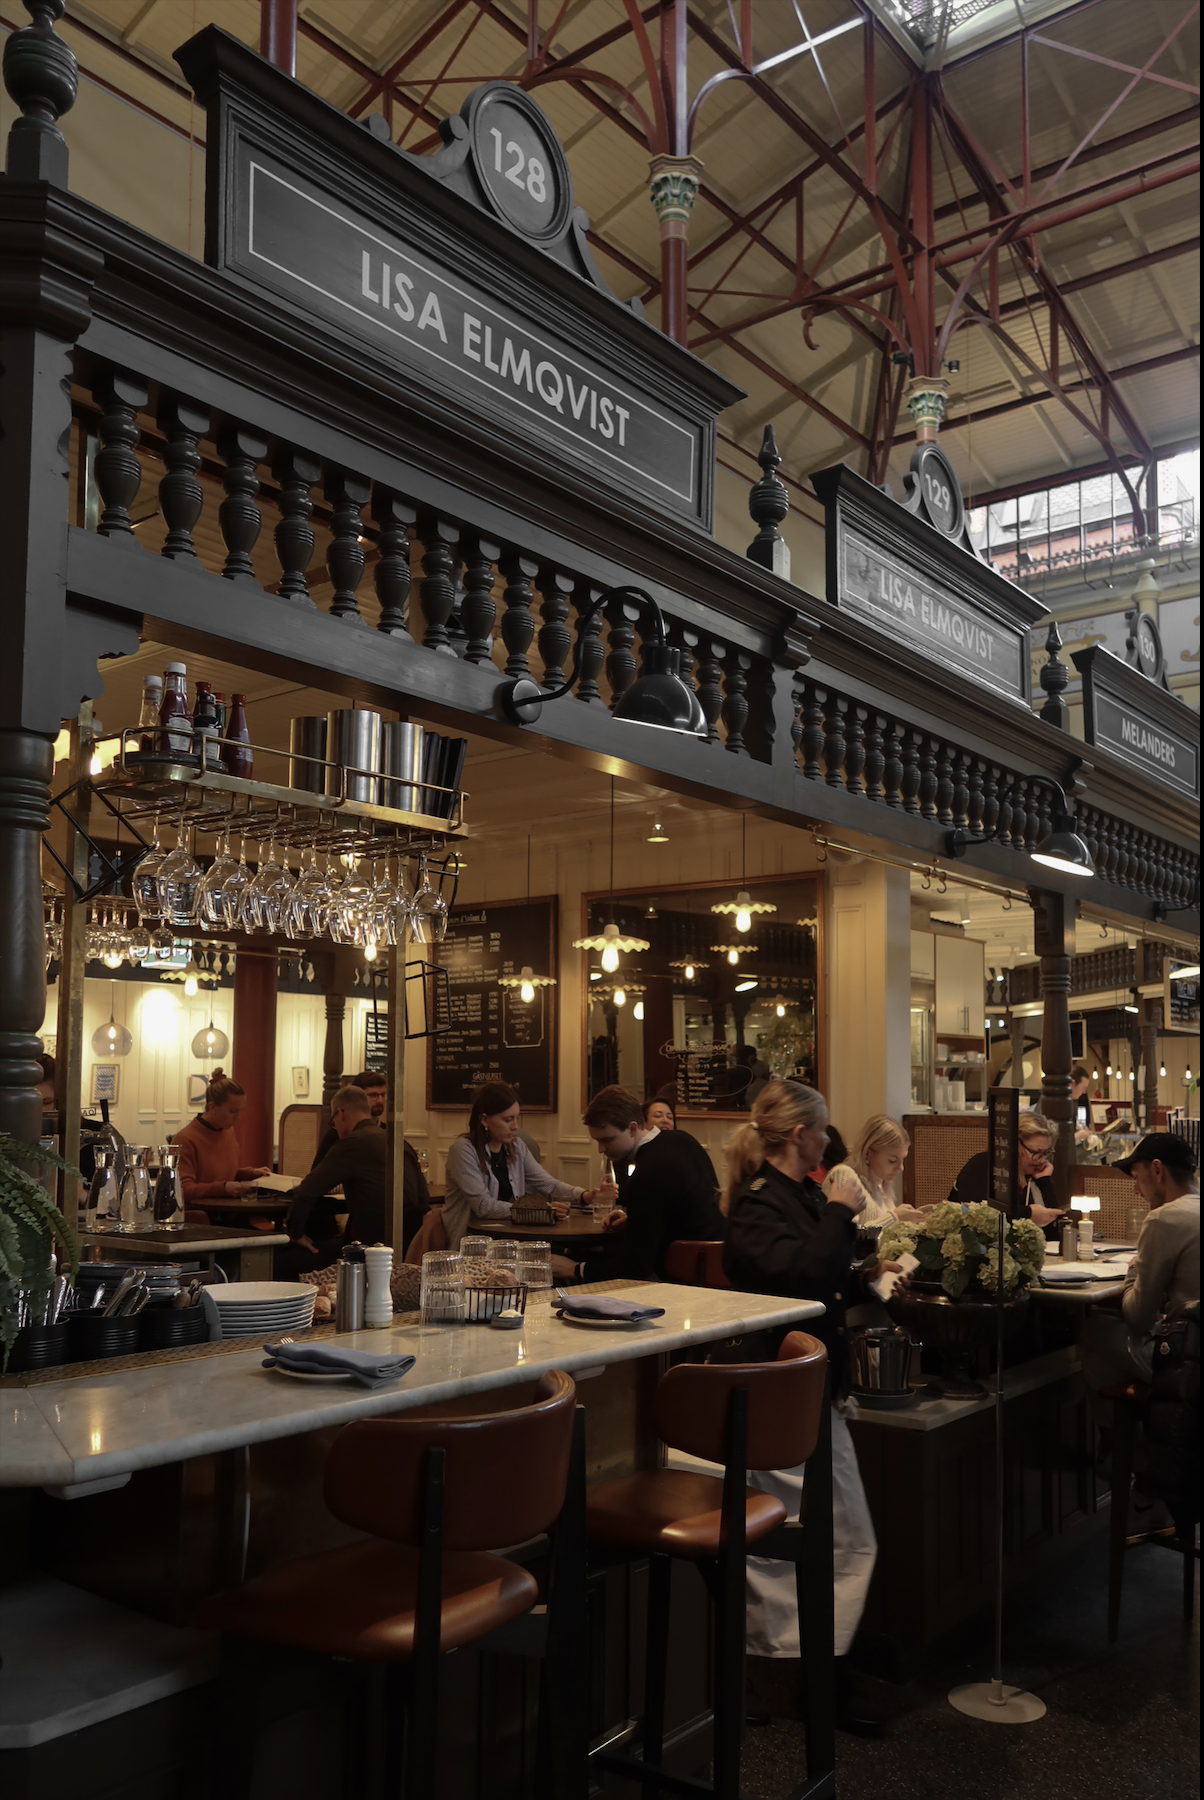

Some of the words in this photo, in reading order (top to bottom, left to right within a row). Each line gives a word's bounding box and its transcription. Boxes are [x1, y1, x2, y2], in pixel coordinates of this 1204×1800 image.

[489, 126, 547, 204] 128
[361, 249, 449, 344] LISA
[463, 311, 631, 447] ELMQVIST
[924, 472, 951, 514] 129
[880, 568, 917, 617] LISA
[920, 593, 994, 662] ELMQVIST
[1139, 633, 1156, 664] 130
[1121, 716, 1176, 768] MELANDERS
